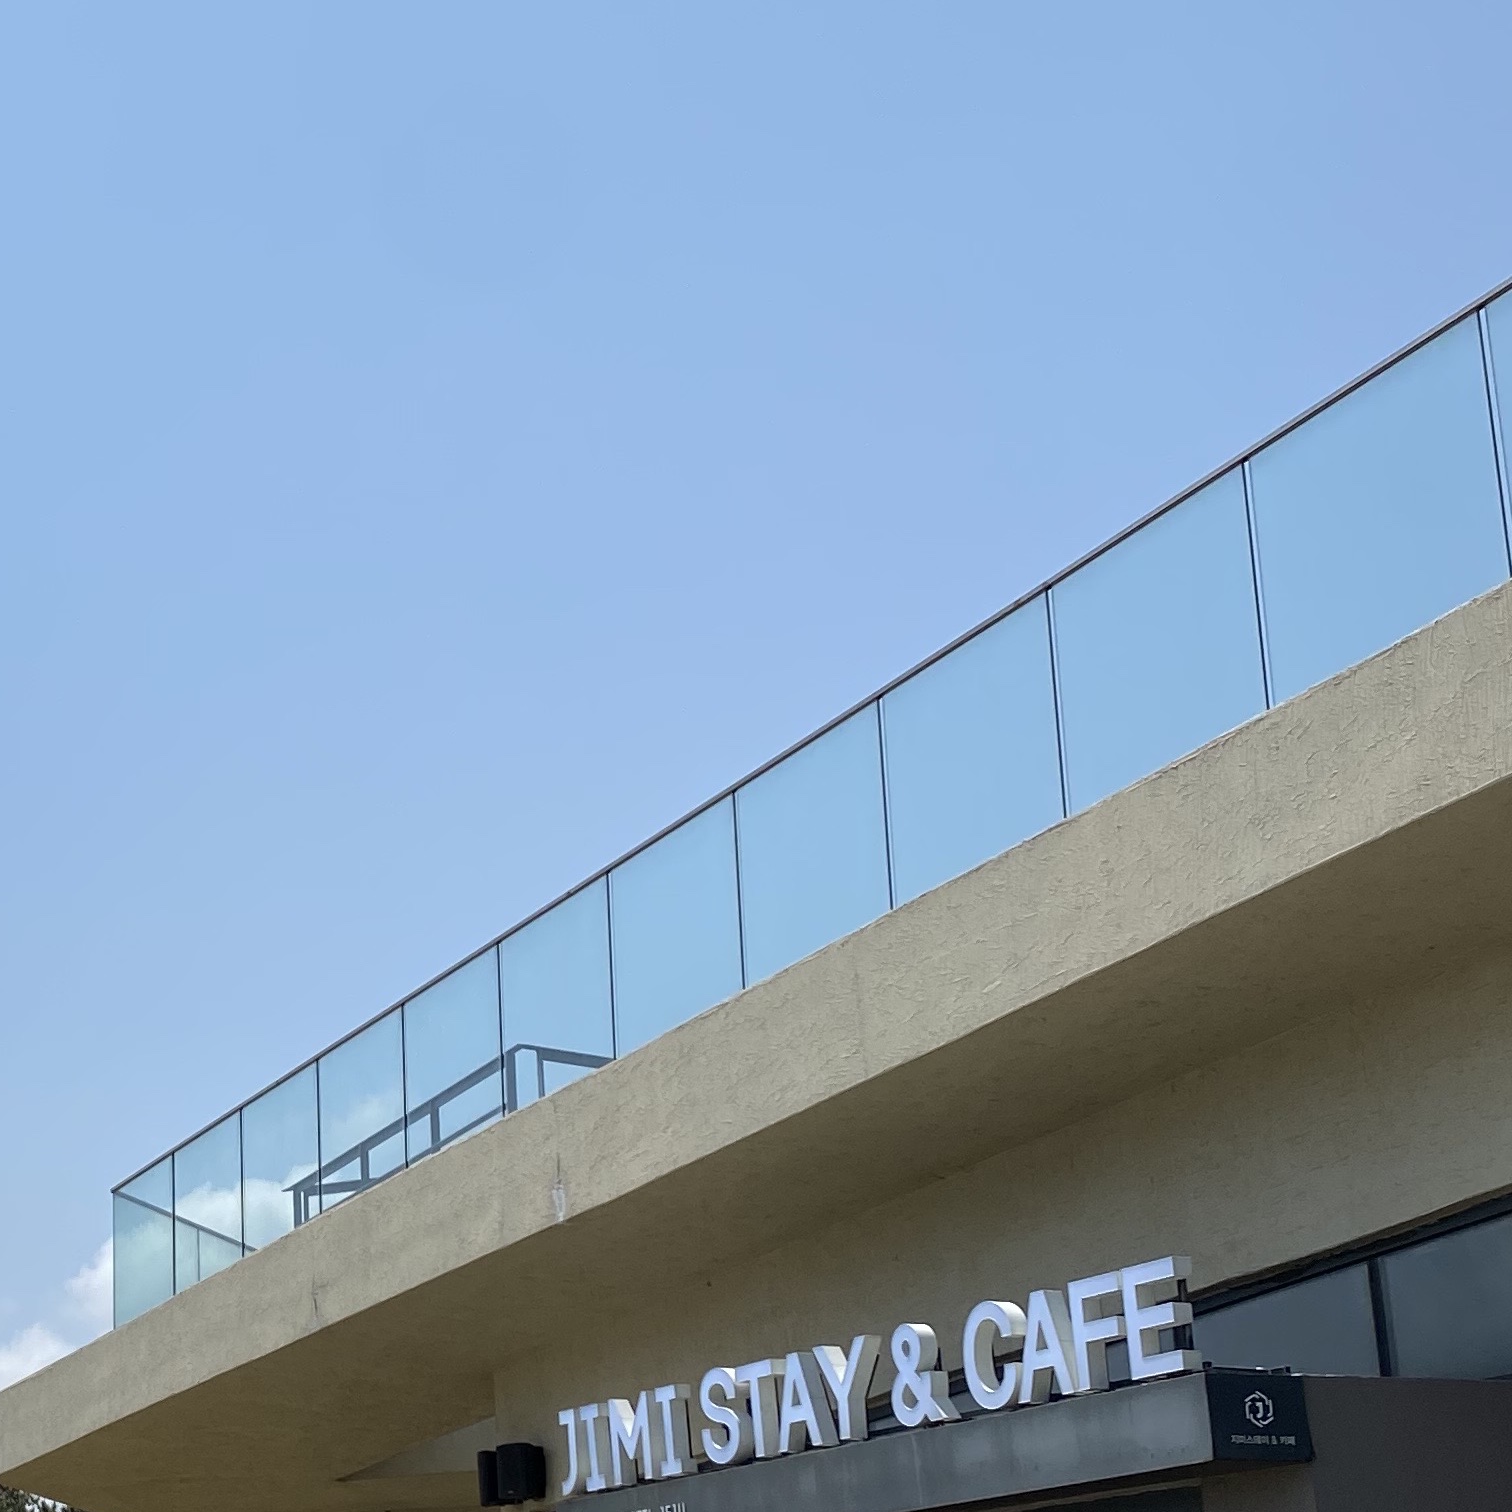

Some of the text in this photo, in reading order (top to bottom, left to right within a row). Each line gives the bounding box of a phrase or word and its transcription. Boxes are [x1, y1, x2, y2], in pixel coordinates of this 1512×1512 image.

[558, 1256, 1201, 1496] JIMI STAY & CAFE
